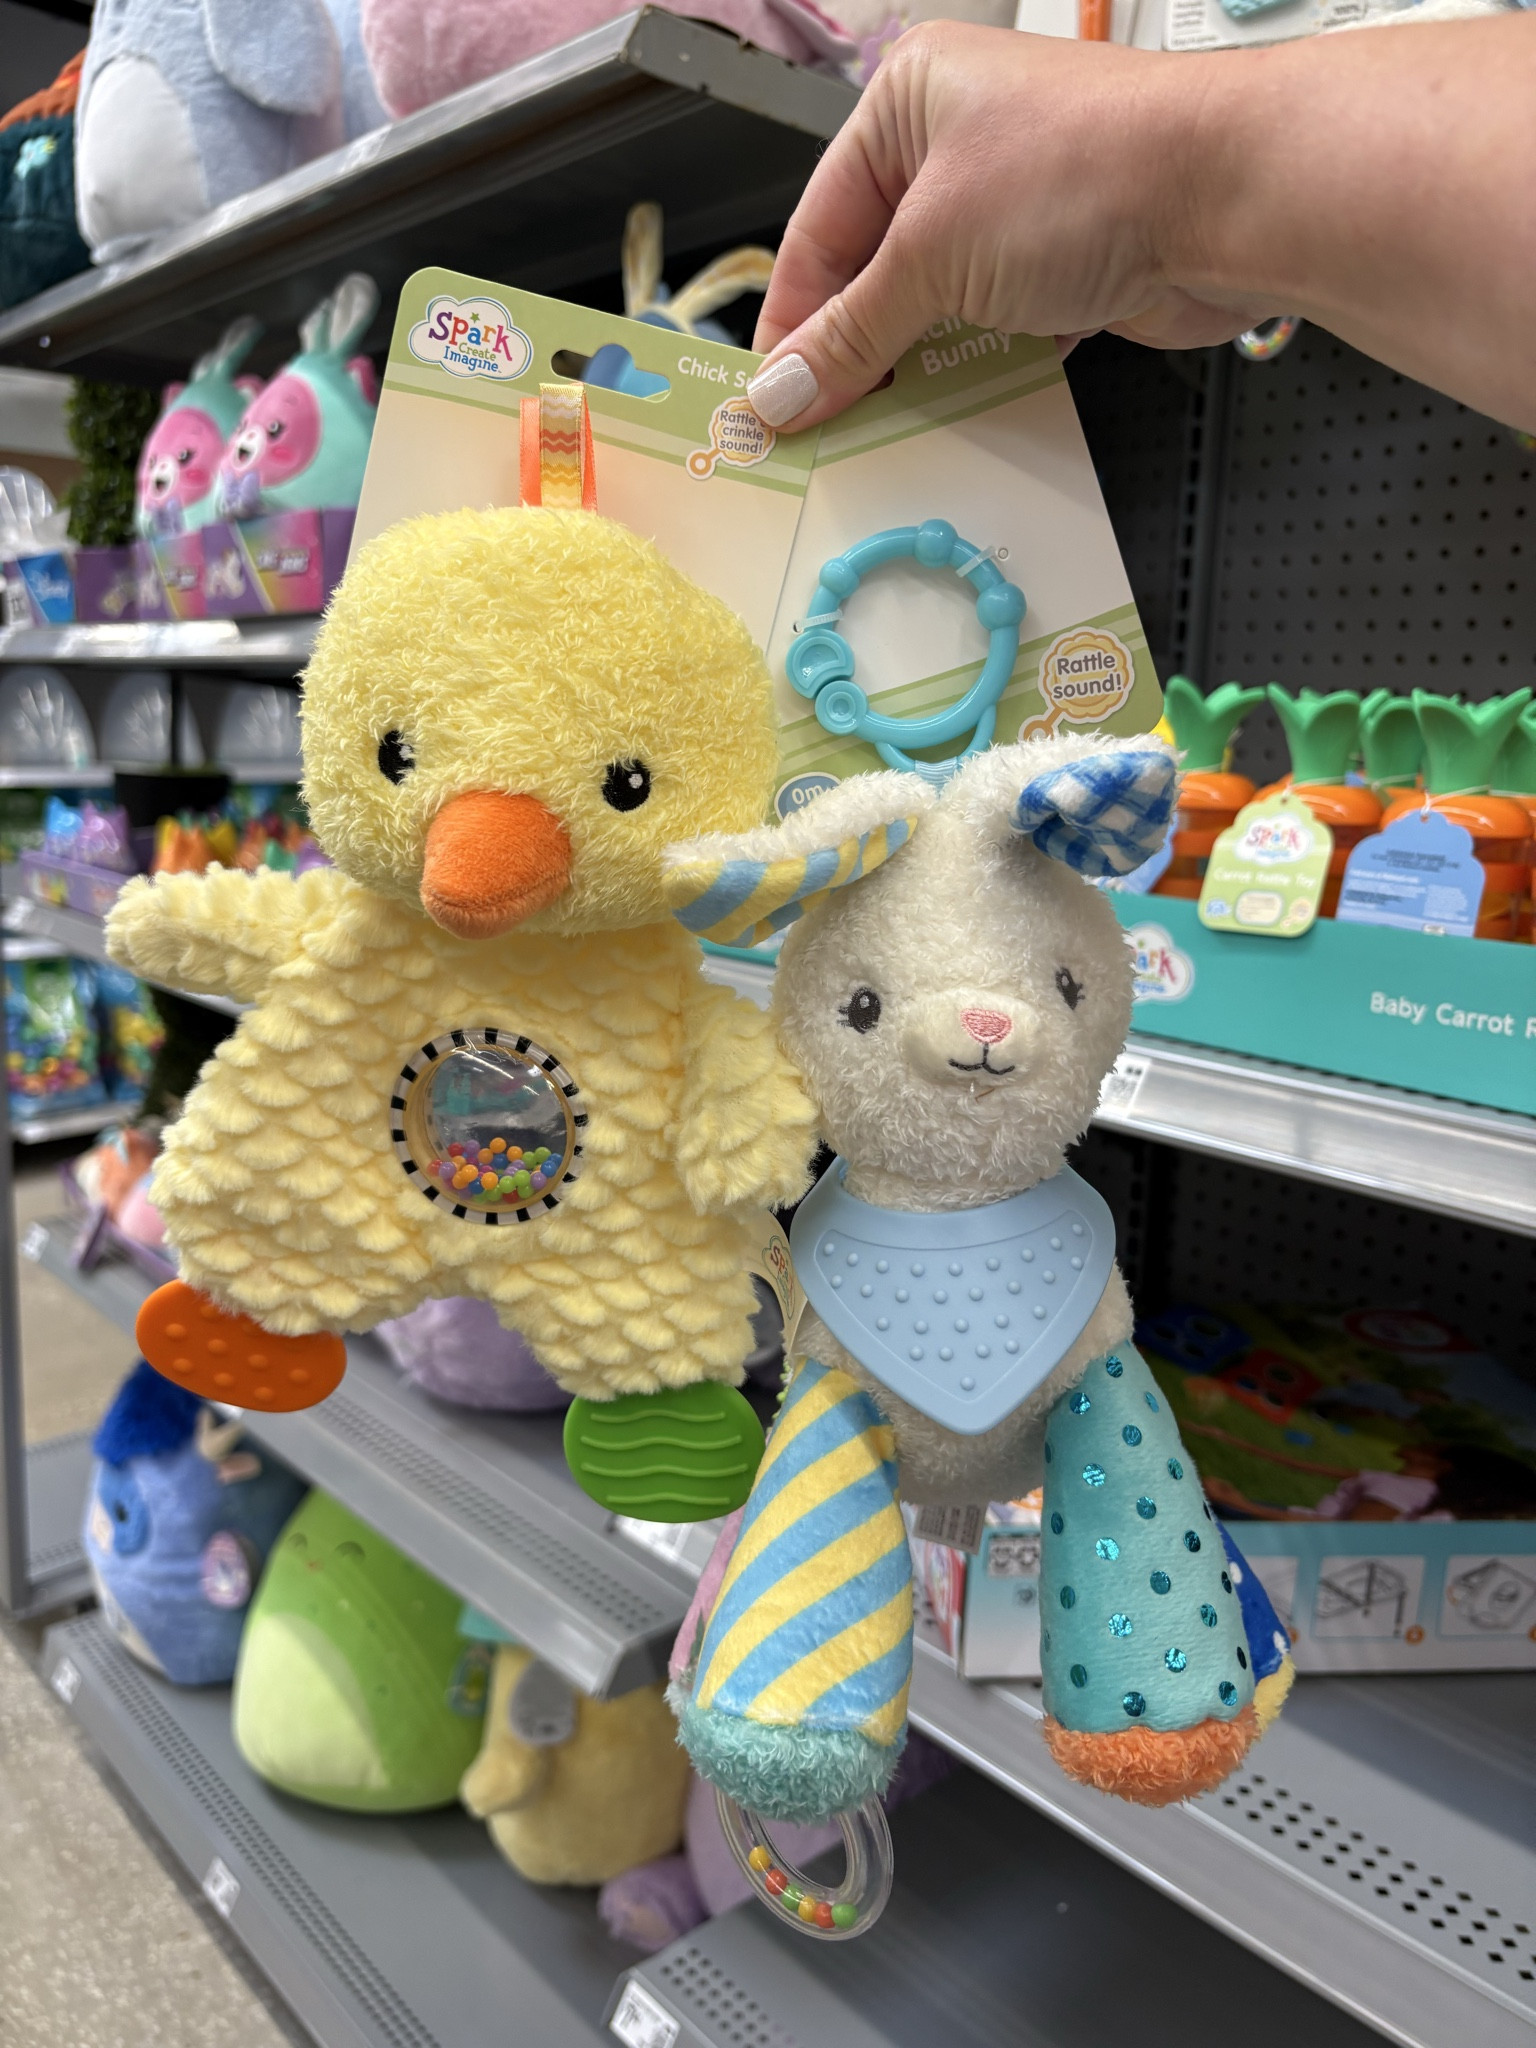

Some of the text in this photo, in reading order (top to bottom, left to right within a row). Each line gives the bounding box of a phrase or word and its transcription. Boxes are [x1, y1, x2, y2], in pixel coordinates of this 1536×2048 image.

[427, 311, 513, 361] Spark
[443, 345, 499, 372] Imagine
[458, 342, 497, 362] Create
[920, 331, 1010, 376] Bunny
[677, 355, 729, 385] Chick
[720, 410, 757, 426] Rattle
[719, 439, 763, 454] sound!
[722, 426, 764, 441] crinkle
[1056, 651, 1116, 675] Rattle
[1053, 673, 1122, 699] sound!
[1370, 991, 1427, 1025] Baby
[1435, 1002, 1516, 1037] Carrot
